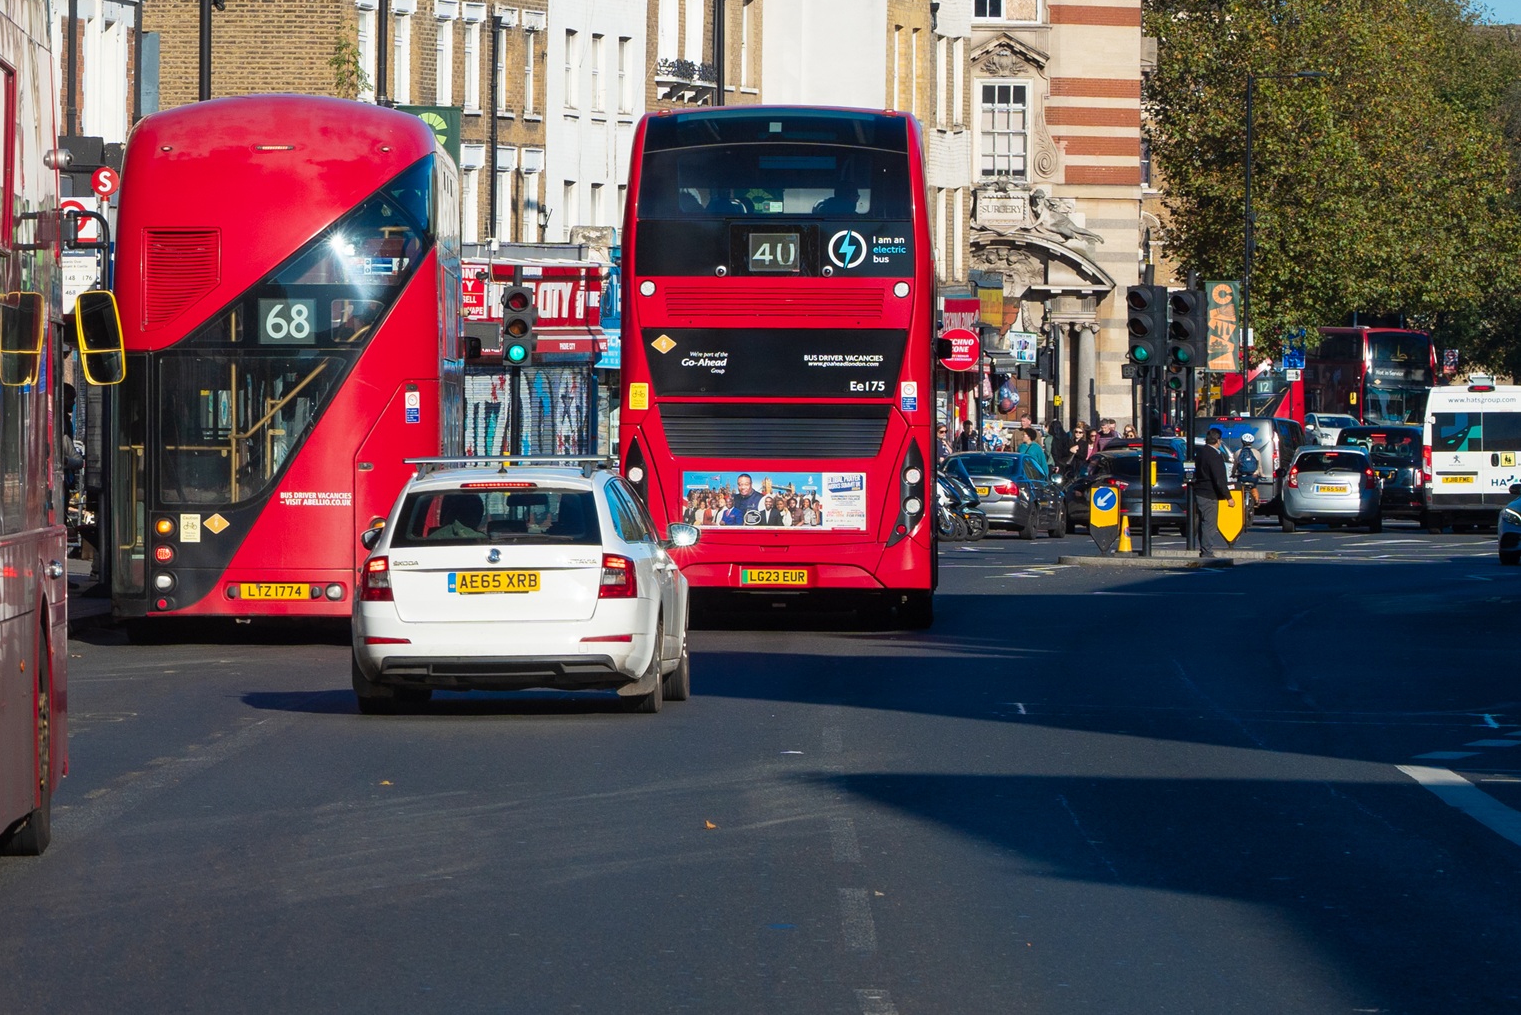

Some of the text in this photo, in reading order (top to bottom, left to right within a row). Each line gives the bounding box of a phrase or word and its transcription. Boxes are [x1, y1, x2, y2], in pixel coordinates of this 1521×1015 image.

[99, 171, 111, 192] S
[981, 205, 1022, 213] SURGERY
[873, 236, 876, 244] I
[873, 246, 906, 254] electric
[873, 255, 889, 263] bus
[538, 282, 572, 319] CITY
[266, 304, 310, 339] 68
[681, 358, 727, 367] Go-Ahead
[804, 354, 883, 362] BUS DRIVER VACANCIES
[711, 367, 725, 375] Group
[850, 381, 885, 392] Ee175
[1260, 382, 1269, 392] 12
[460, 573, 537, 589] AE65 XRB
[750, 571, 805, 582] LG23 EUR
[248, 585, 301, 597] LTZ 1774
